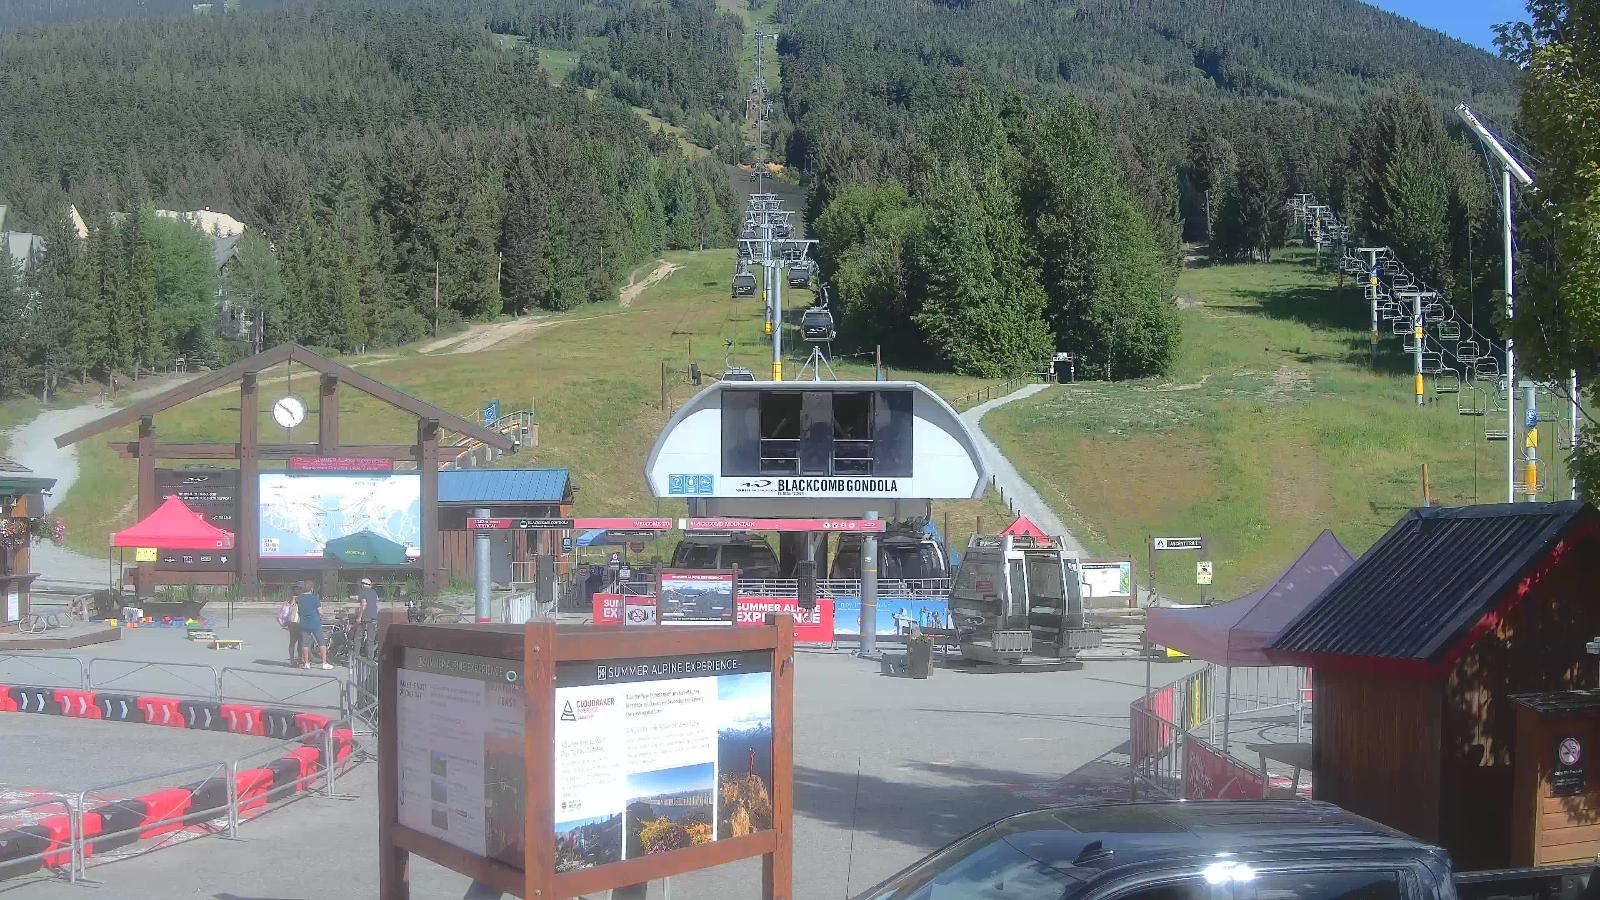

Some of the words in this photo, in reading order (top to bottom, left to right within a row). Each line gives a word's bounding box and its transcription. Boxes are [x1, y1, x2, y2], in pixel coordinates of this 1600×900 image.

[778, 479, 845, 492] BLACKCOMB
[846, 479, 898, 492] GONDOLA
[737, 602, 781, 612] SUMMER
[783, 603, 820, 613] ALPE
[608, 664, 649, 678] SUMMER
[651, 662, 683, 675] ALPINE
[685, 659, 737, 673] EXPERIENCE
